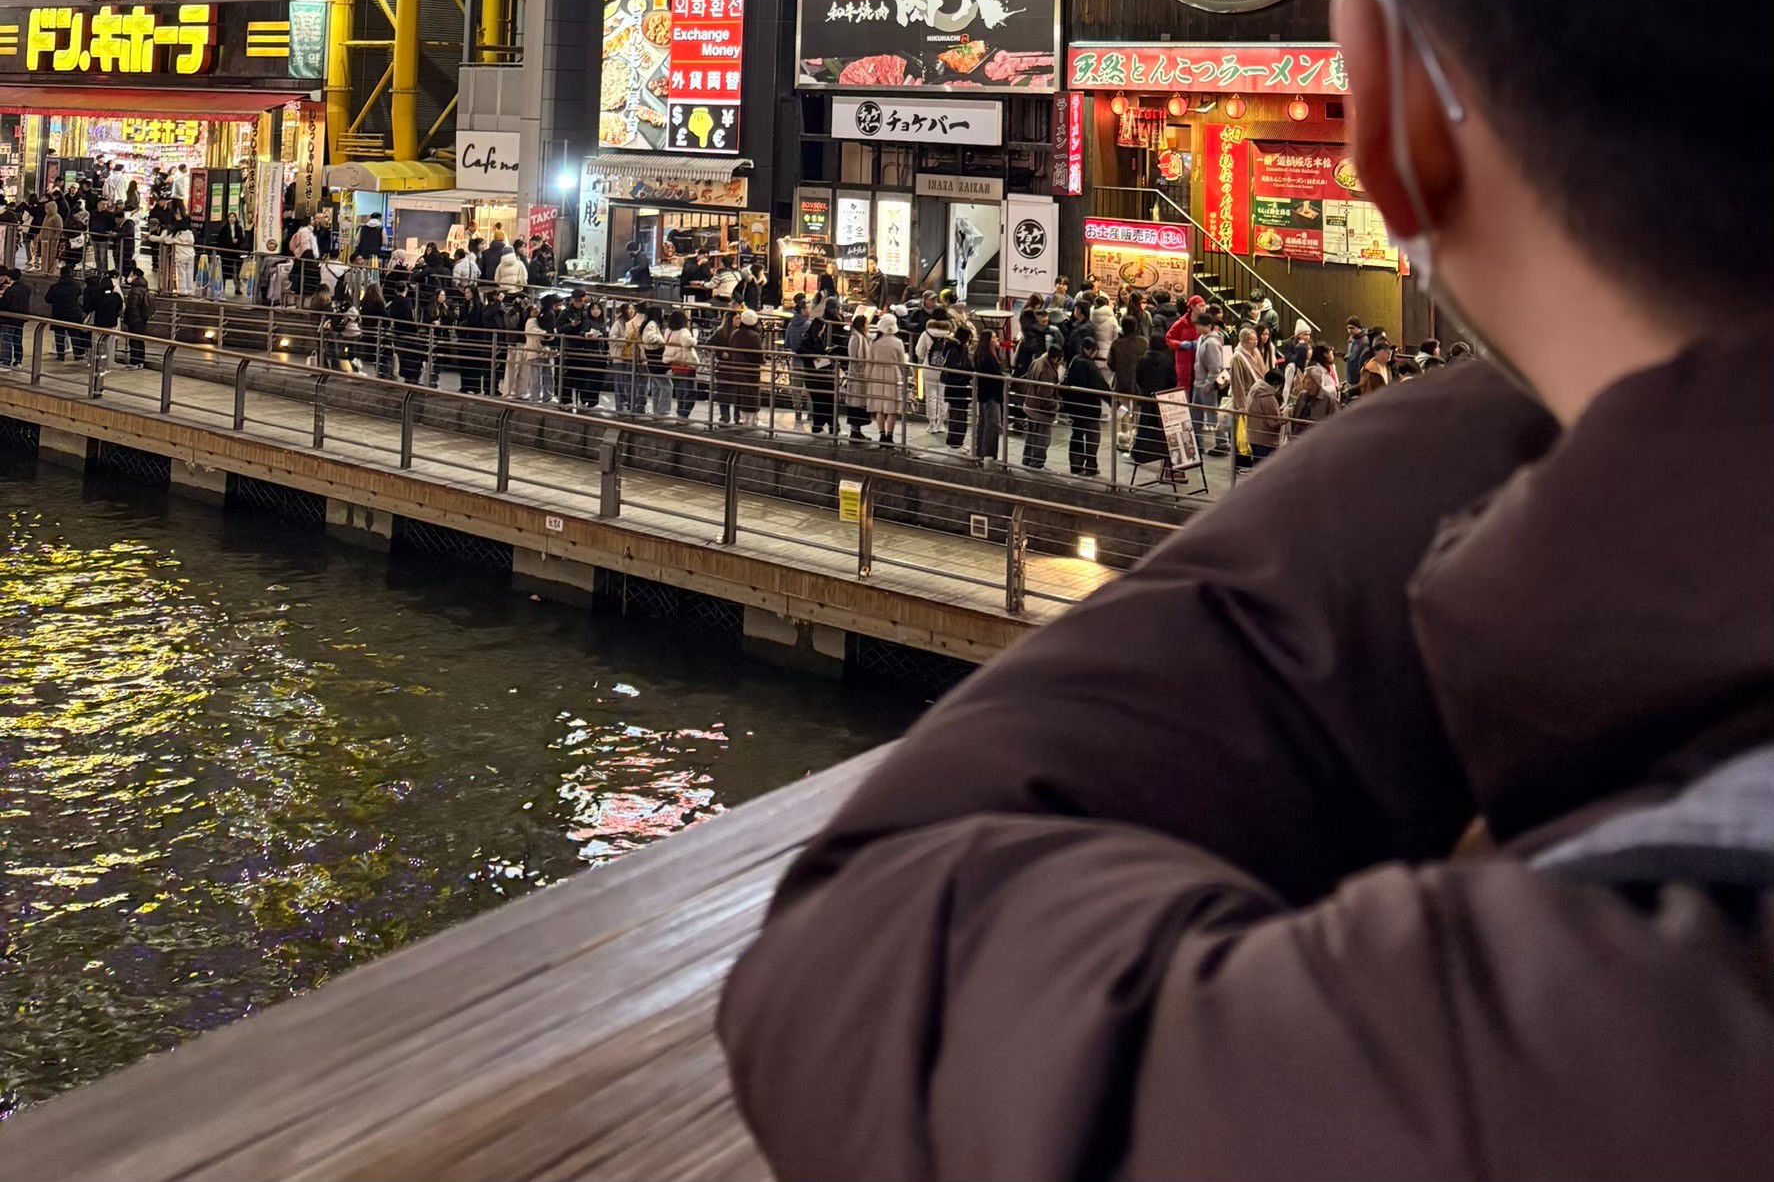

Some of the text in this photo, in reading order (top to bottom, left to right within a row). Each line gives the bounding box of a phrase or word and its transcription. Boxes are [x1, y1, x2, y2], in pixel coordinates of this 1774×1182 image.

[673, 27, 730, 44] Exchange
[926, 34, 960, 43] NIKUHACHI
[702, 44, 741, 59] Money
[1071, 49, 1349, 92] 天然とんこつラーメン専
[886, 109, 971, 135] チョケバー
[462, 143, 497, 174] Cafe
[530, 208, 558, 225] TAKO
[1085, 223, 1183, 245] お土産販売所 はい
[1012, 264, 1047, 275] チョケバー
